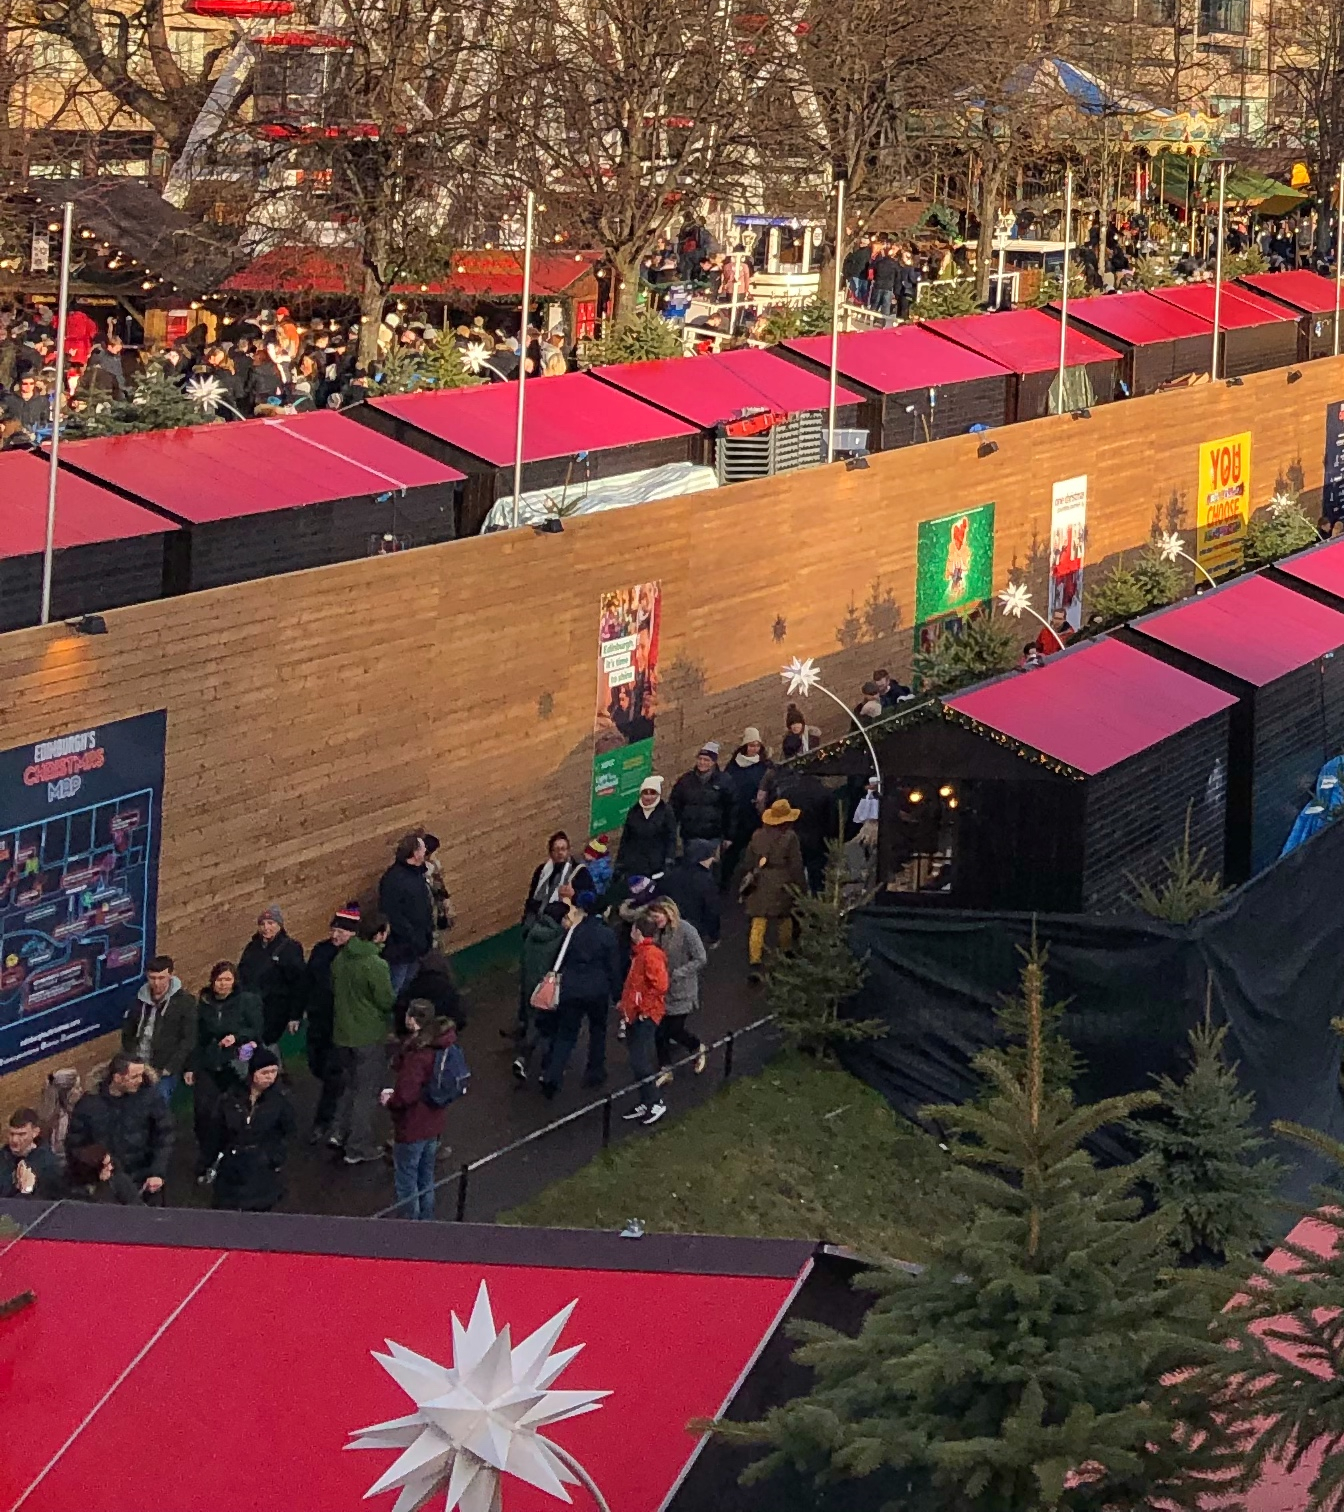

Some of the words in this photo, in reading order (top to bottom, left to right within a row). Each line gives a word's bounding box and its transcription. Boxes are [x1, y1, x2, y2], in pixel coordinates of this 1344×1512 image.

[1209, 442, 1242, 491] YOU
[1207, 498, 1240, 528] CHOOSE
[603, 638, 634, 654] Edinburgh
[34, 730, 96, 763] EDINBURGH'S
[23, 747, 105, 786] CHRISTMAS
[47, 774, 82, 802] MAP
